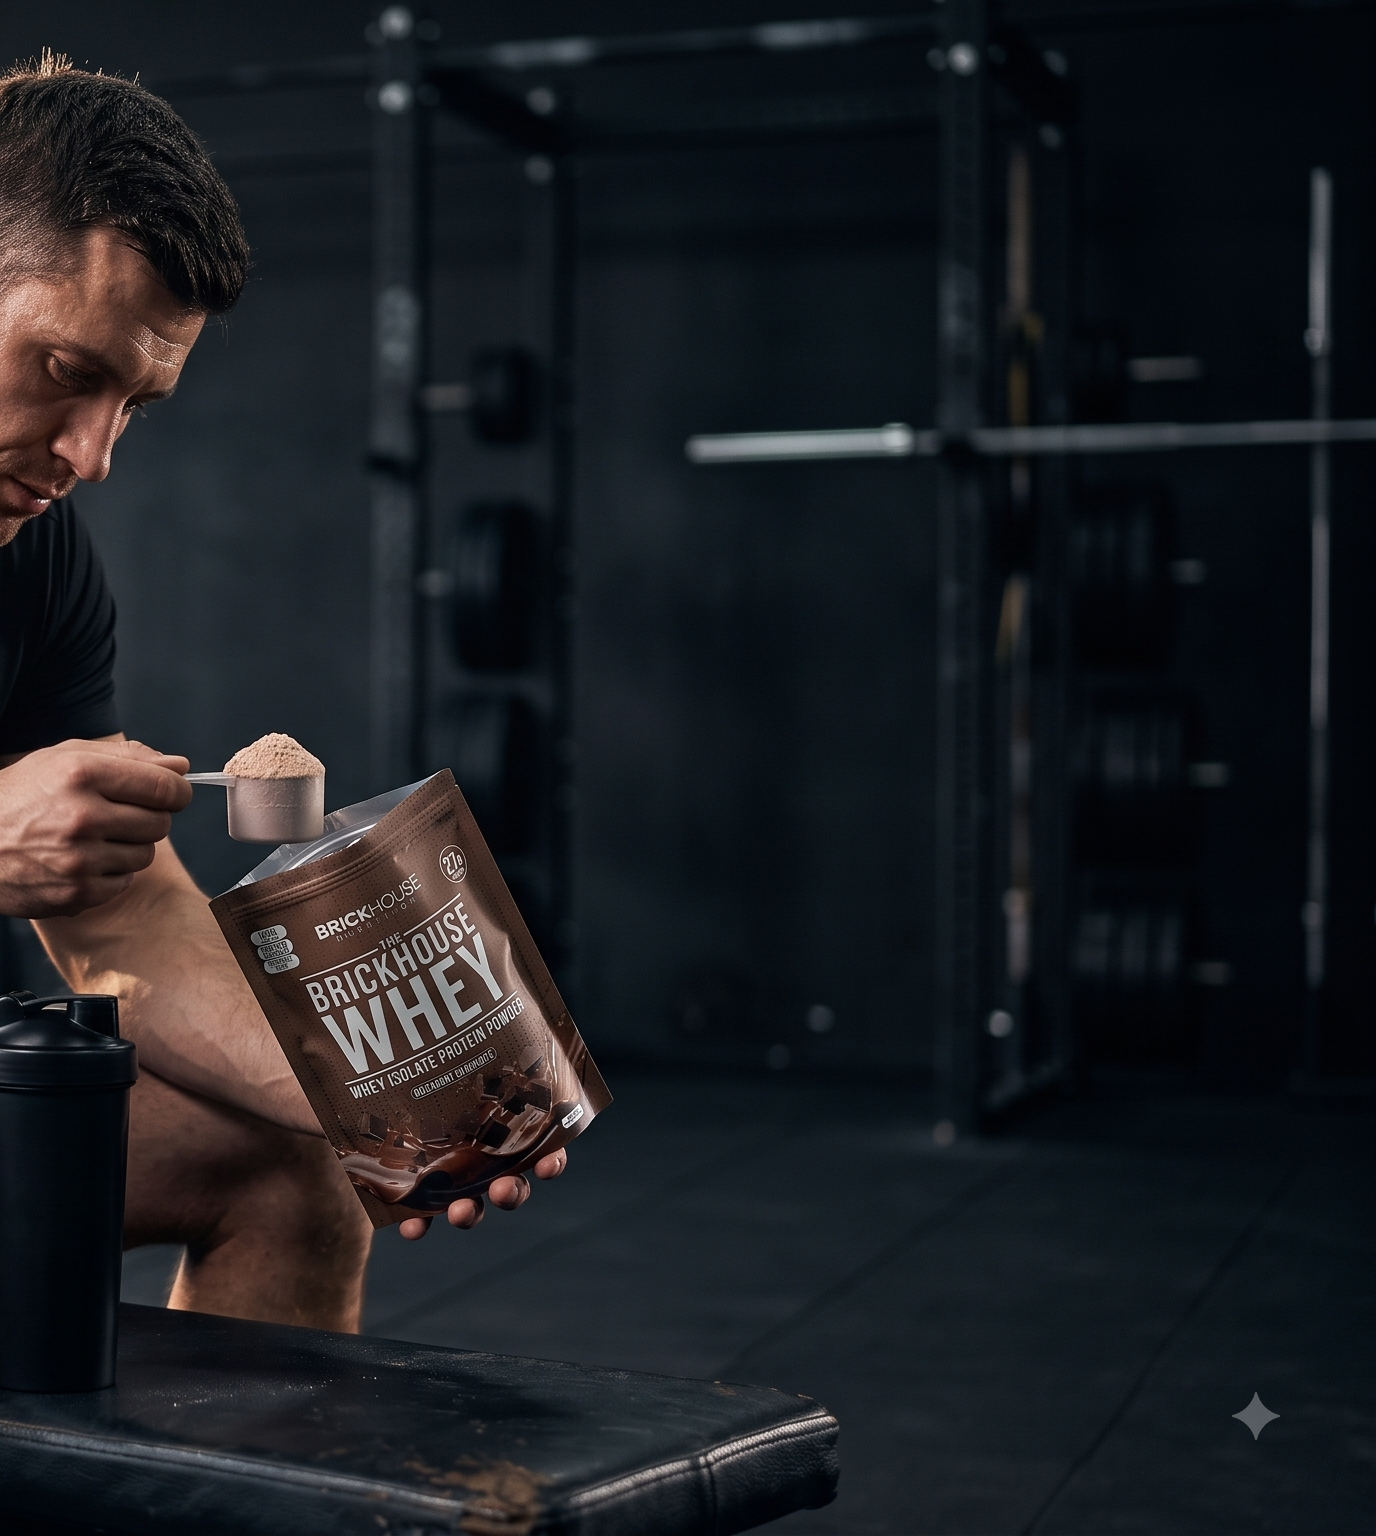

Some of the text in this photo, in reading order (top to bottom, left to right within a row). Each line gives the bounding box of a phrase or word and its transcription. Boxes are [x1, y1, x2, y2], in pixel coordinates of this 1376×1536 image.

[314, 873, 422, 940] BRICKHOUSE
[378, 931, 403, 950] THE
[305, 901, 476, 1013] BRICKHOUSE
[320, 932, 504, 1075] WHEY
[349, 1076, 386, 1099] WHEY
[387, 1054, 438, 1087] ISOLATE
[439, 1026, 487, 1064] PROTEIN
